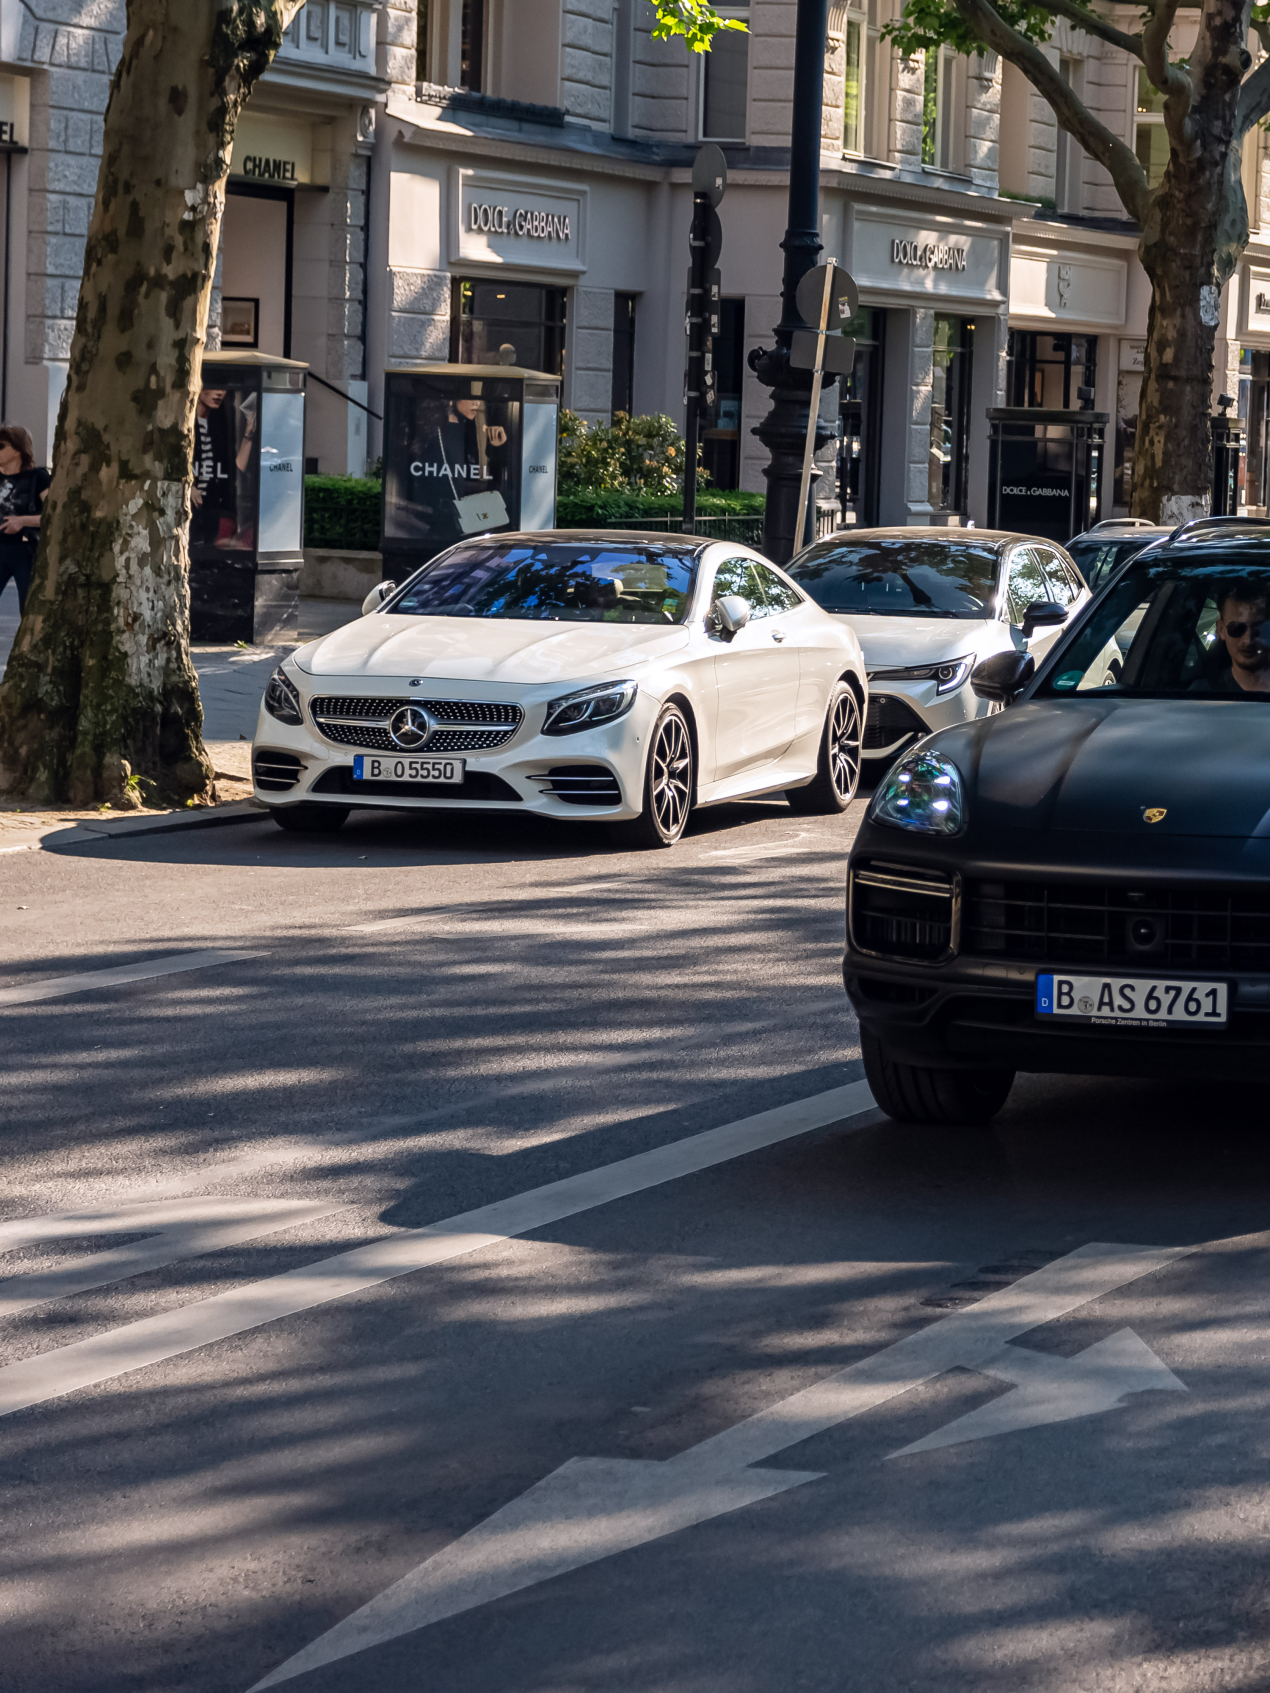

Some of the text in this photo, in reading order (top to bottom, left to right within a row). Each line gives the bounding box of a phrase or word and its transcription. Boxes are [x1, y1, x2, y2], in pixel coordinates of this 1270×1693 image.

[243, 155, 297, 180] CHANEL
[471, 203, 508, 233] DOLCE
[515, 209, 571, 240] GABBANA
[926, 243, 967, 270] GABBANA
[269, 462, 293, 473] CHANEL
[410, 461, 493, 480] CHANEL
[529, 465, 548, 474] CHANEL
[1003, 486, 1026, 495] DOLCE
[1031, 487, 1069, 497] GABBANA
[371, 759, 381, 777] B
[408, 761, 454, 780] 5550
[1057, 979, 1075, 1010] B
[1096, 982, 1136, 1014] AS
[1143, 984, 1222, 1018] 6761
[1091, 1017, 1116, 1025] Porsche
[1116, 1018, 1140, 1026] Zentren
